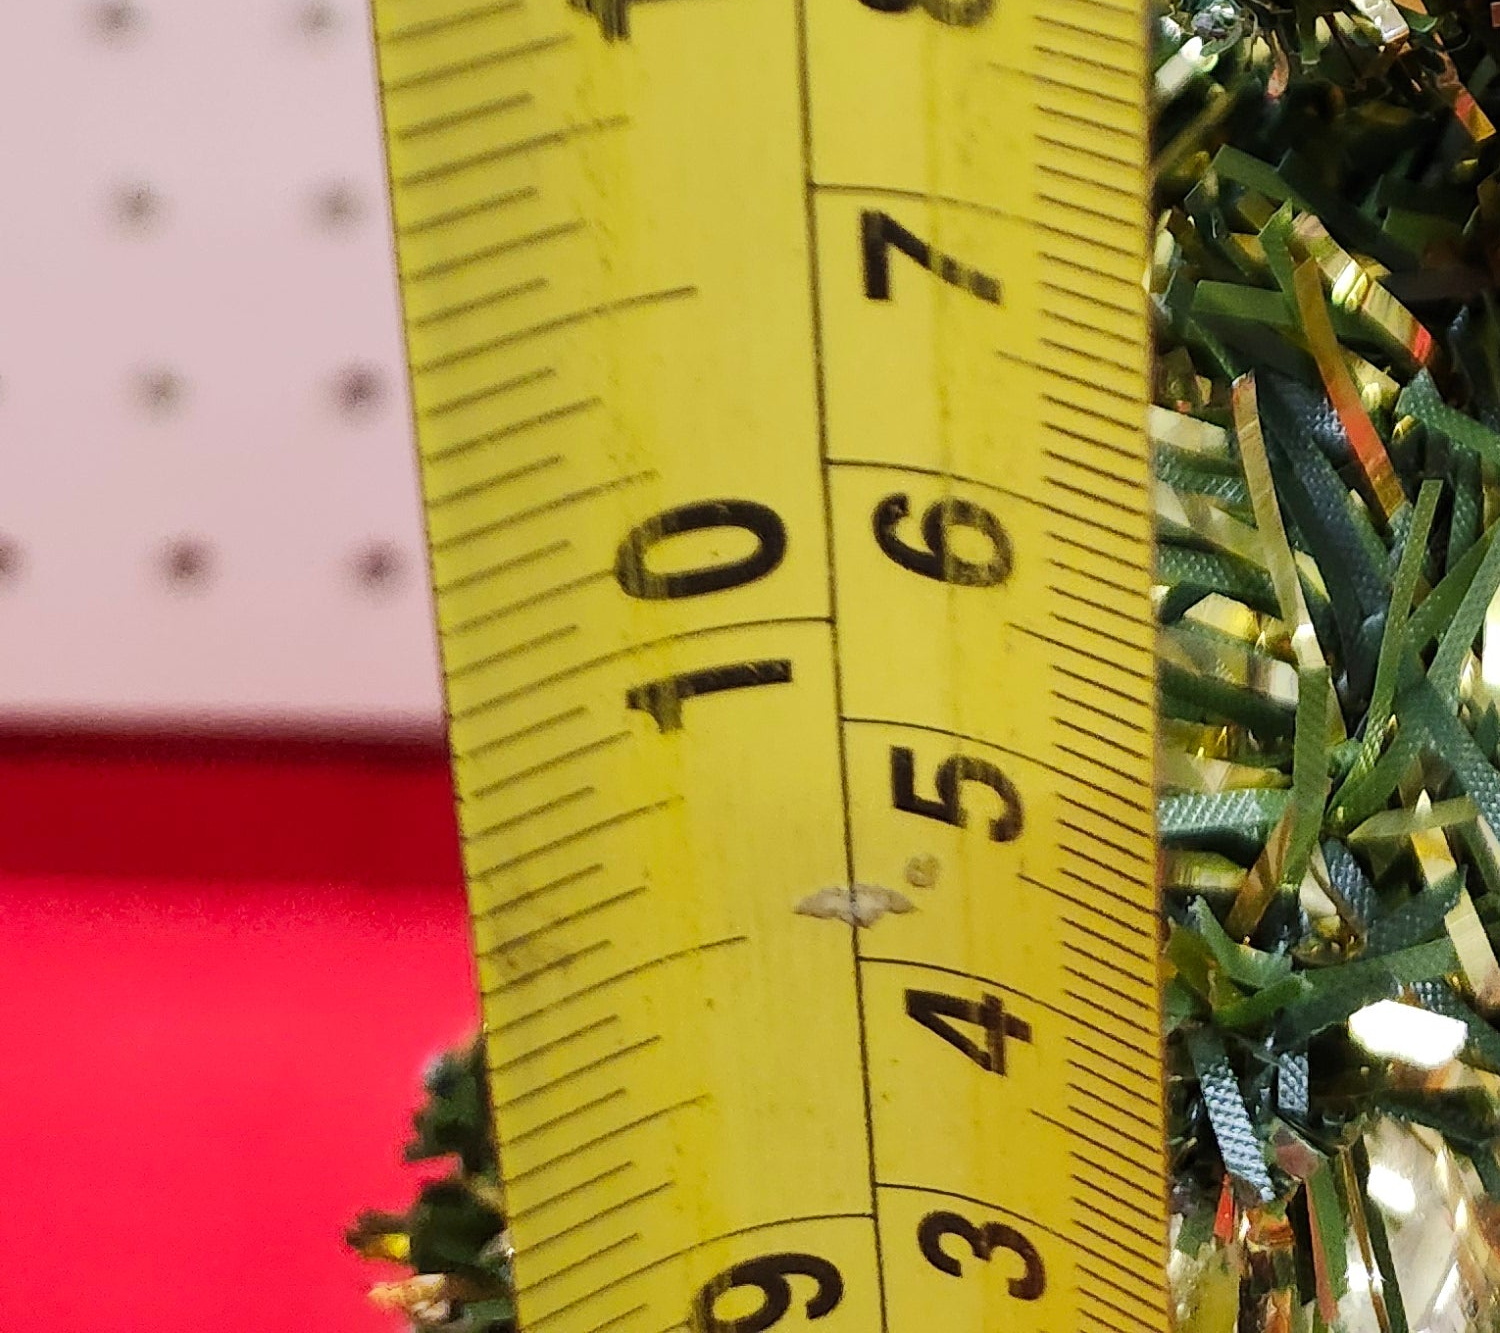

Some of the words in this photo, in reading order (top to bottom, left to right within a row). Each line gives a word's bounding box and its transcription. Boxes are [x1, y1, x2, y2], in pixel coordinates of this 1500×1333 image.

[858, 209, 1003, 306] 7
[871, 492, 1015, 589] 6
[613, 497, 795, 733] 10
[889, 745, 1026, 845] 5
[903, 987, 1033, 1077] 4
[685, 1252, 844, 1333] 9
[917, 1210, 1047, 1303] 3
